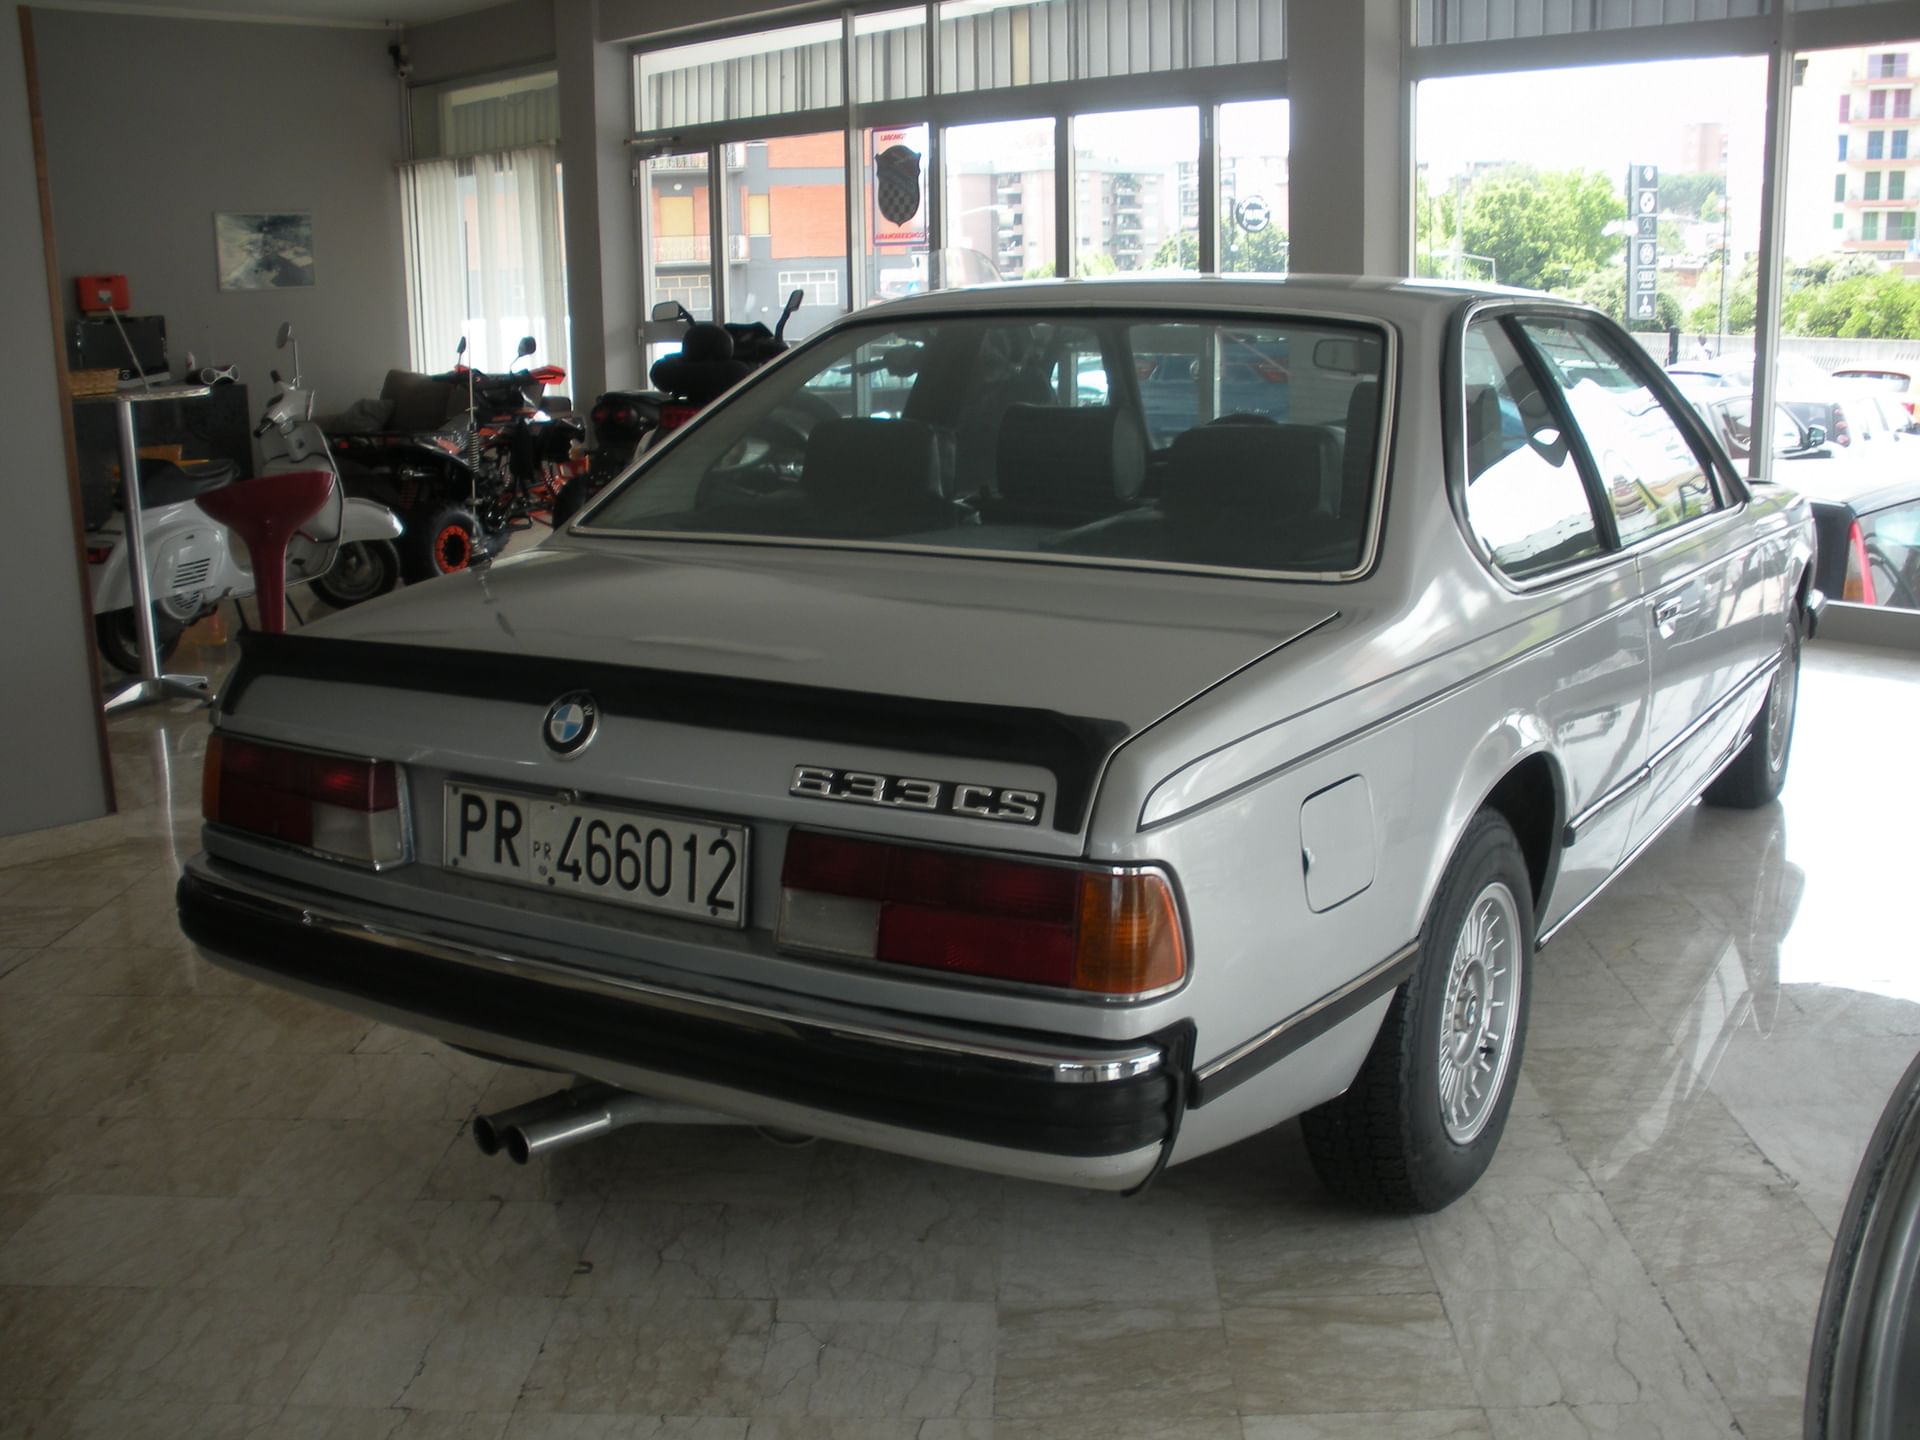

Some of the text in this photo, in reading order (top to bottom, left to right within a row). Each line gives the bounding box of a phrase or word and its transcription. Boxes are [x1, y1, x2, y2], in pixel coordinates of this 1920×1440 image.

[790, 766, 1040, 822] 633 CS
[459, 793, 737, 910] PR PR 466012
